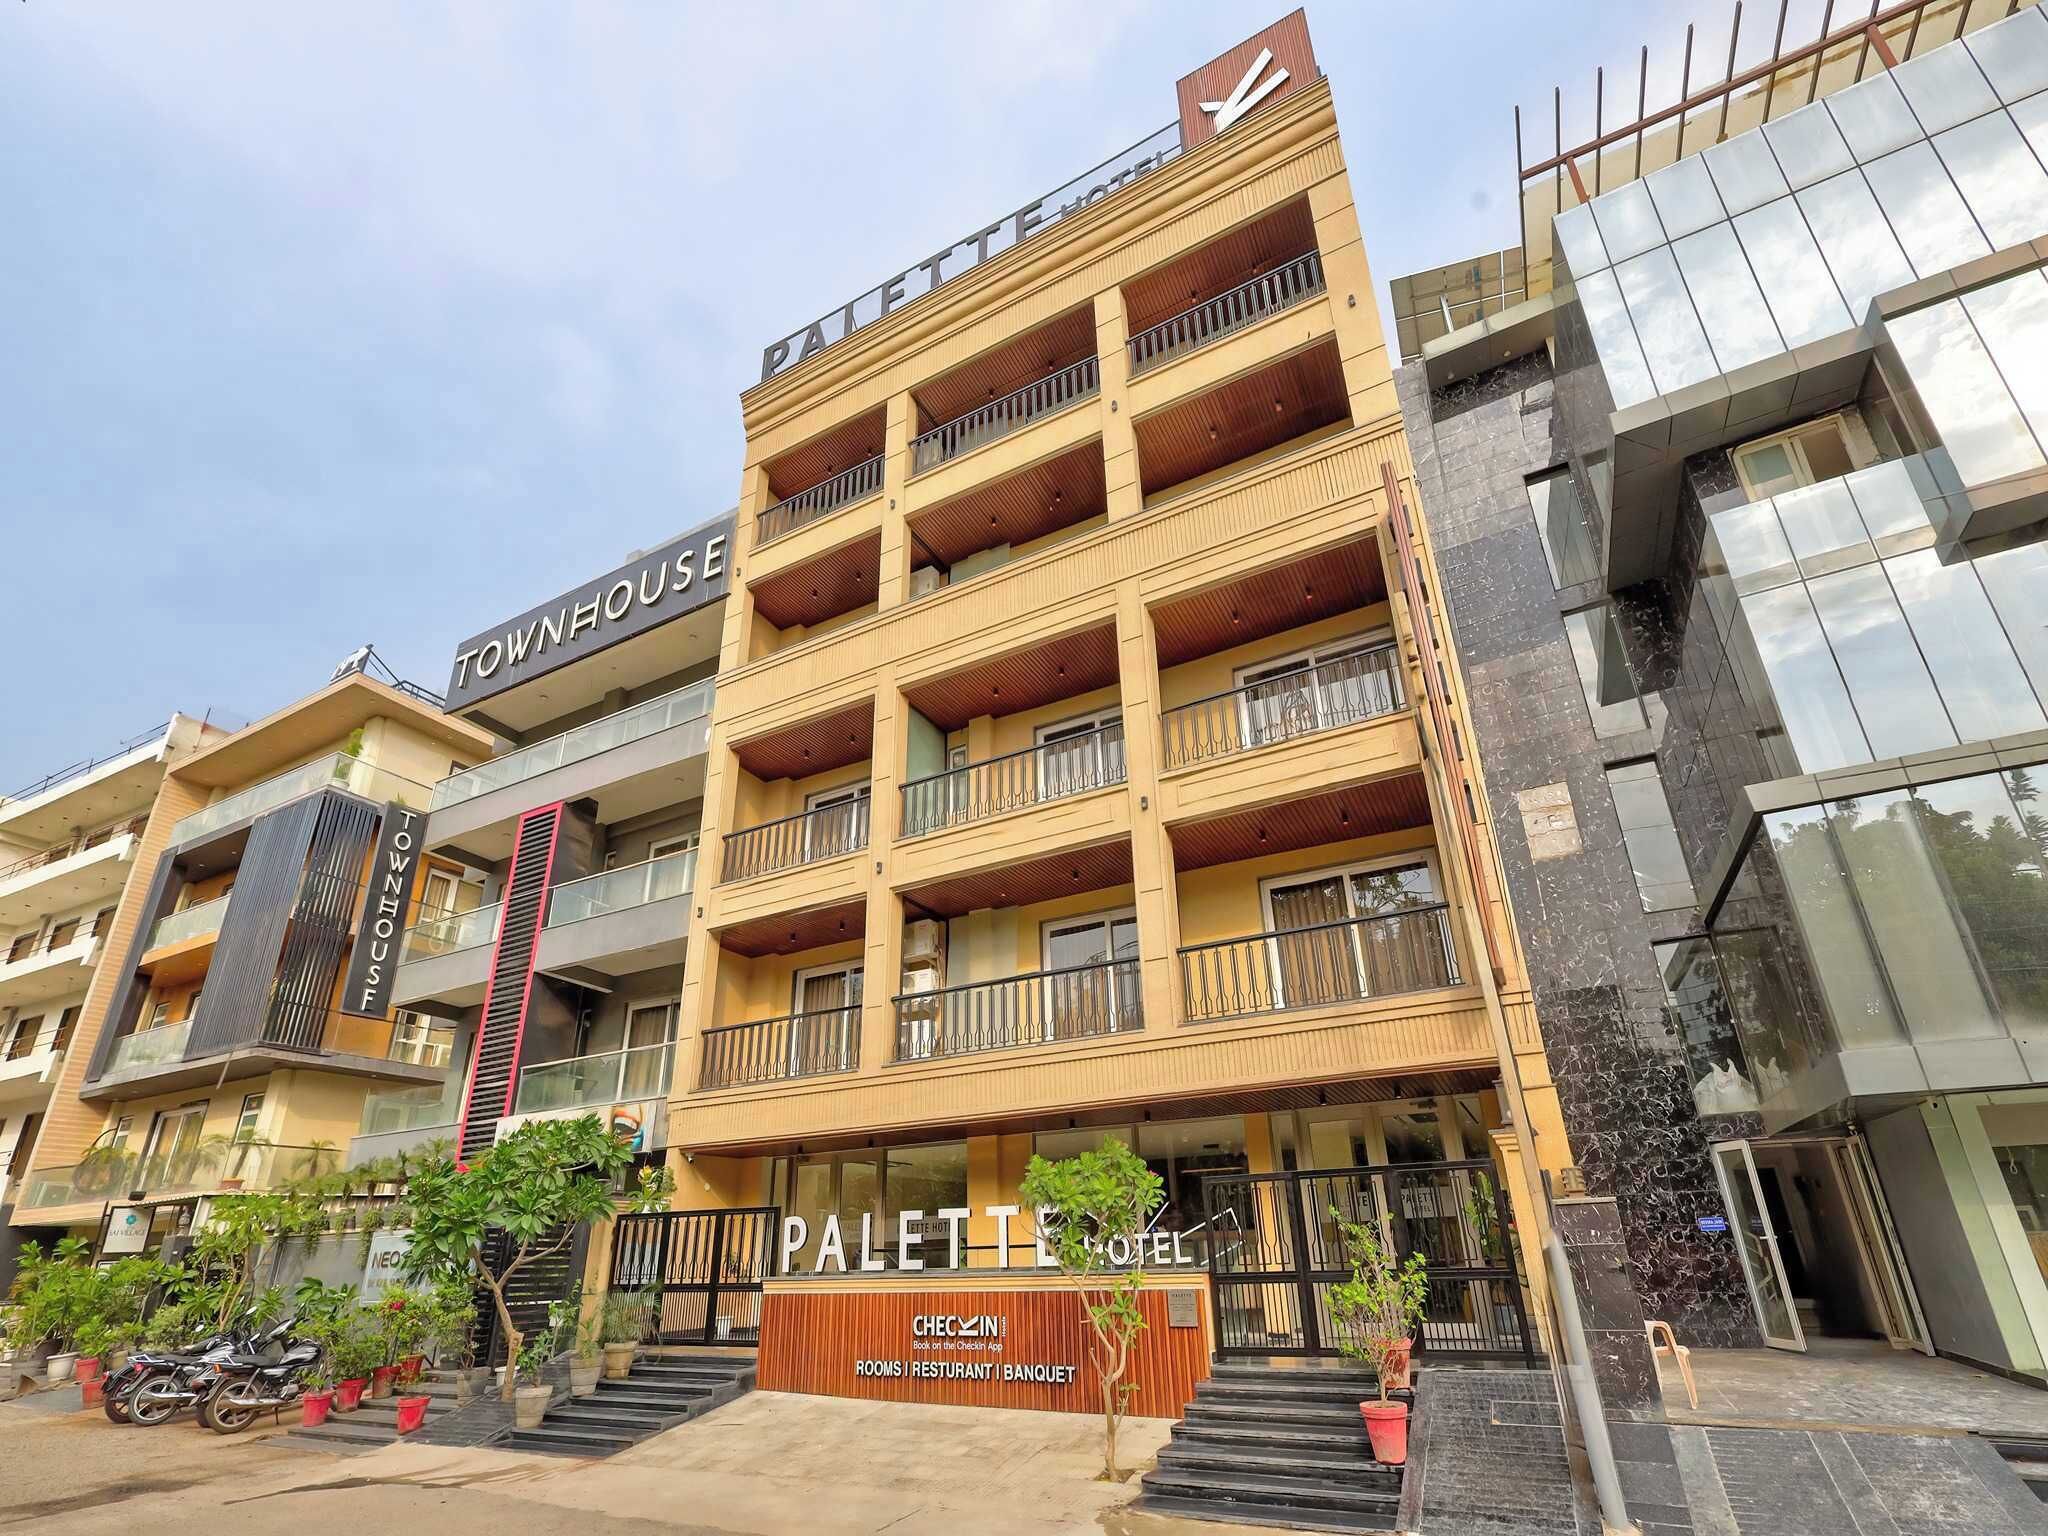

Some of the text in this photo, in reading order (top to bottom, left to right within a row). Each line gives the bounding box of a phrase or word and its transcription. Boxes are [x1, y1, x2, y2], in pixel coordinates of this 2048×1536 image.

[456, 534, 726, 688] TOWNHOUSE
[361, 810, 419, 1011] TOWNHOUSE
[781, 1204, 1062, 1273] PALETTE
[856, 1361, 902, 1377] ROOMS
[912, 1361, 992, 1379] RESTURANT
[1004, 1364, 1075, 1382] BANQUET
[913, 1341, 930, 1350] Book
[943, 1341, 955, 1350] the
[957, 1341, 985, 1351] Checkin
[988, 1342, 1003, 1352] App
